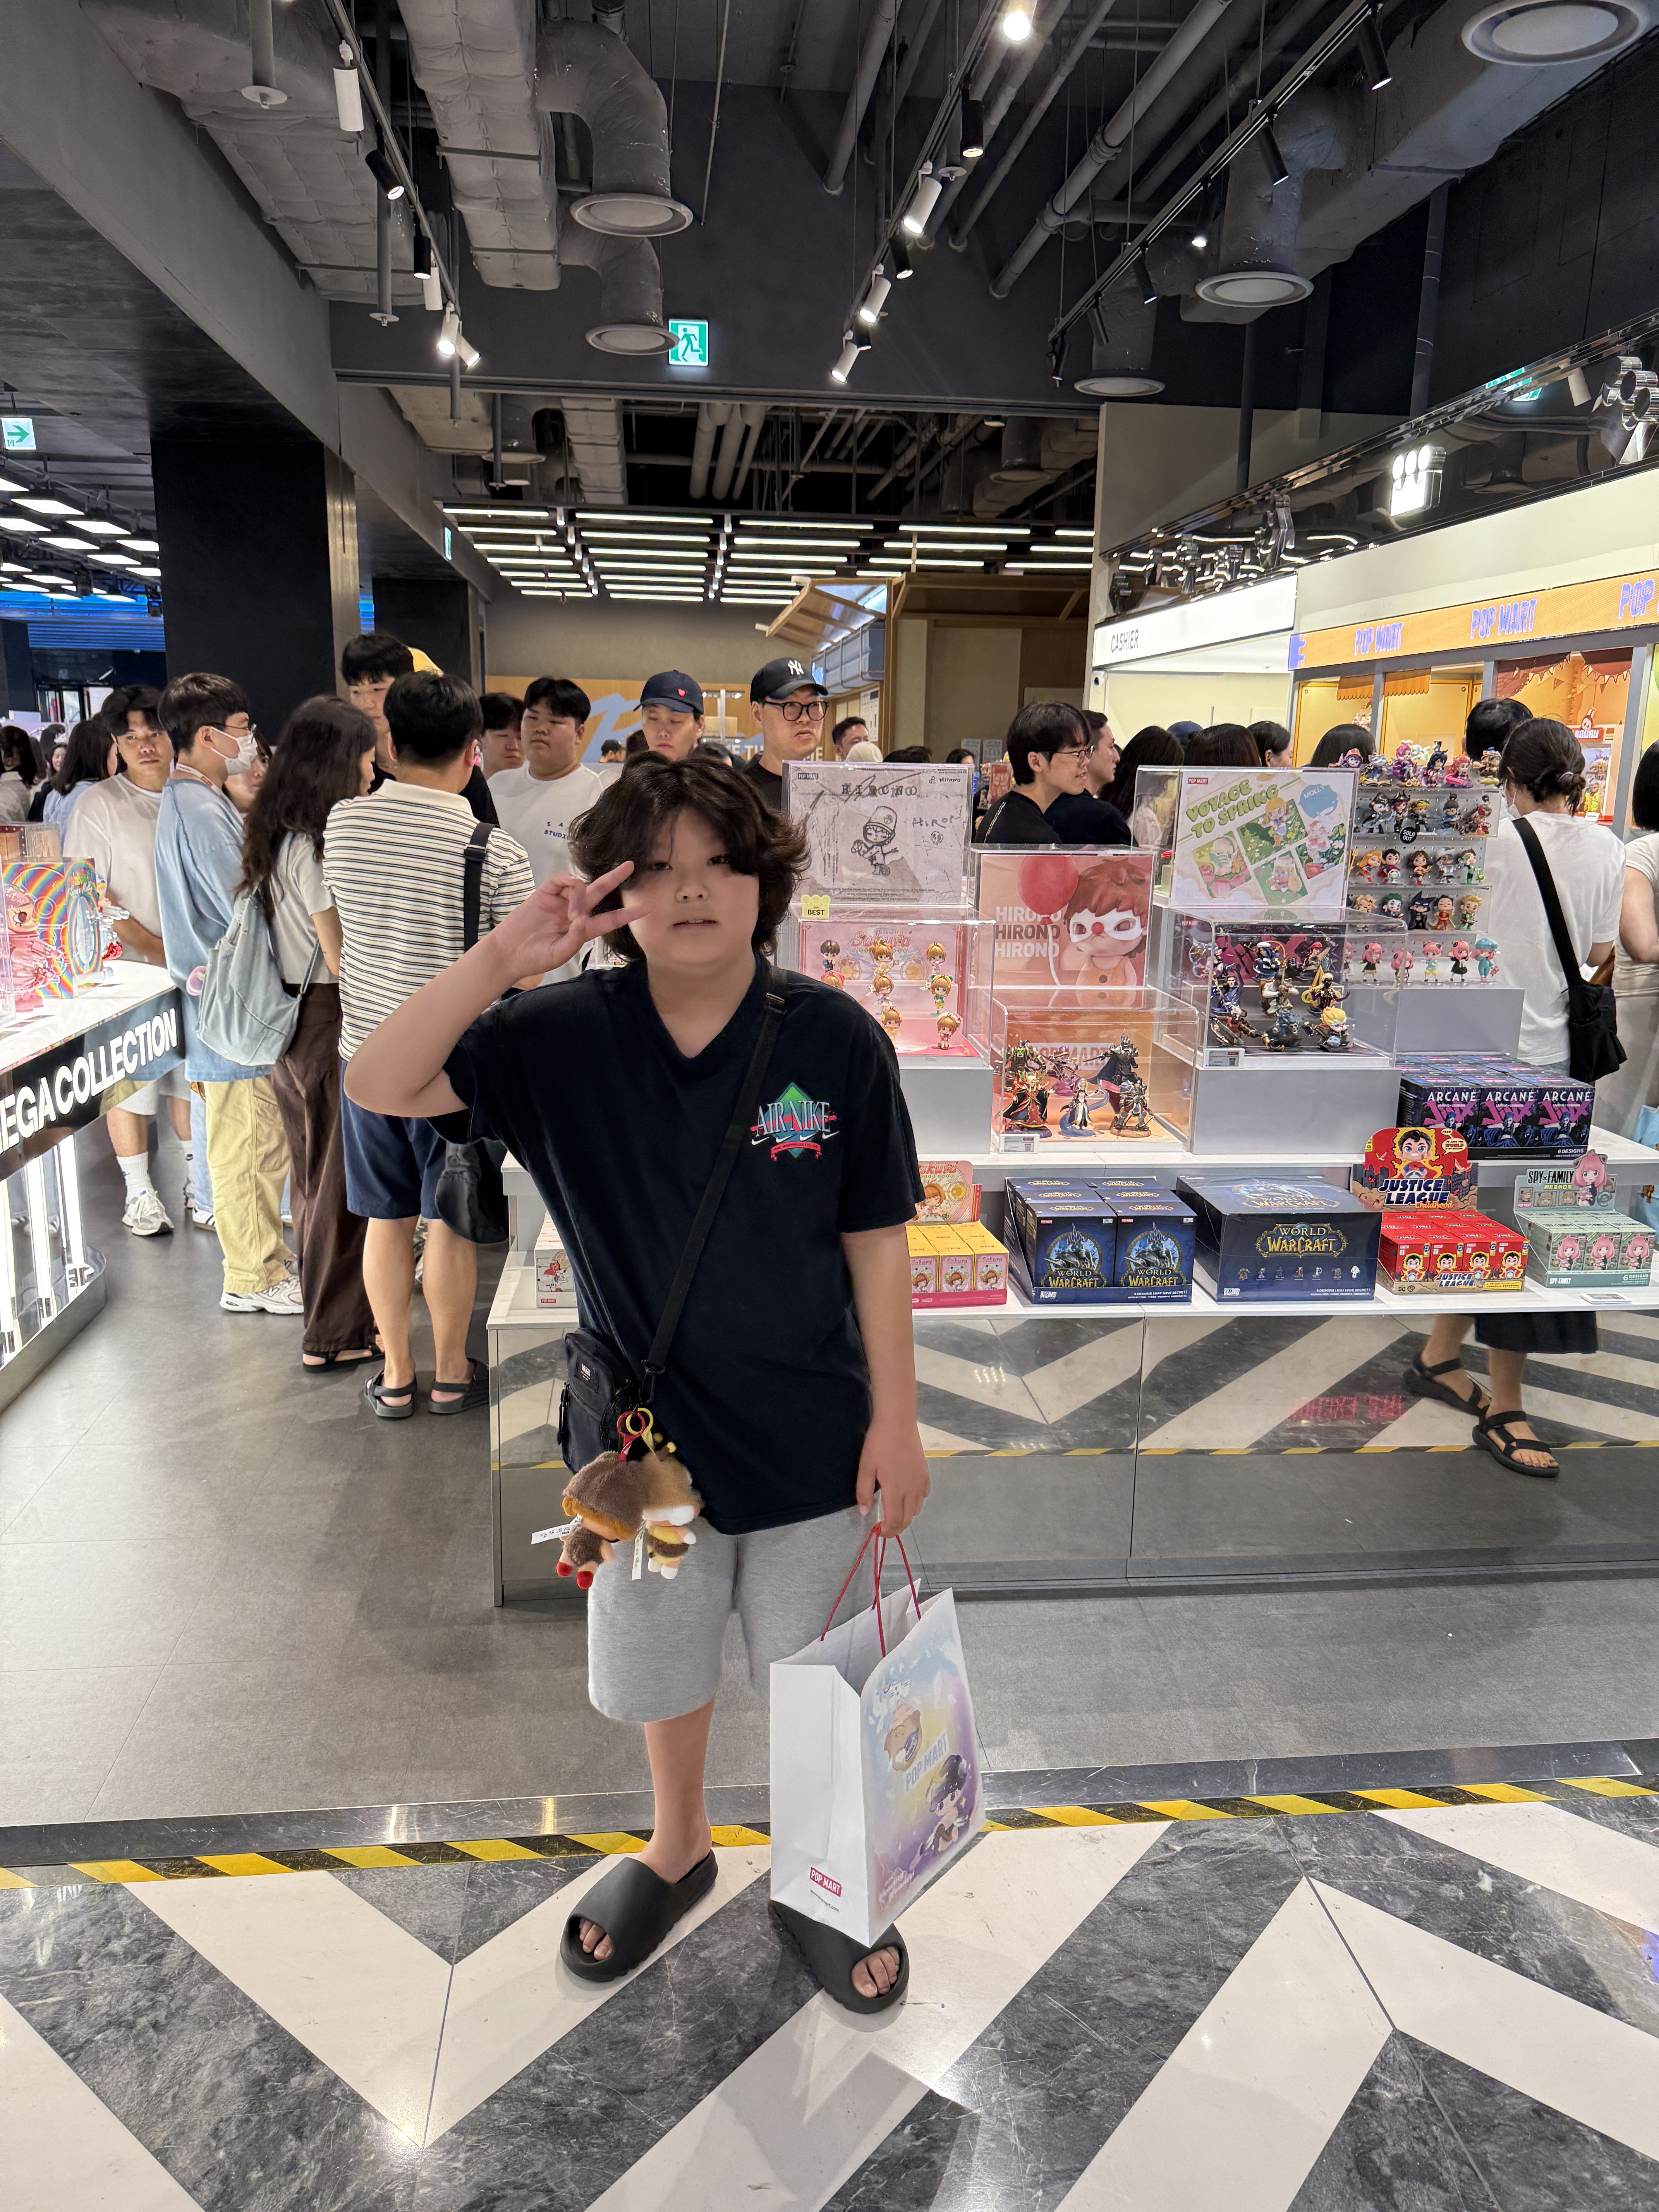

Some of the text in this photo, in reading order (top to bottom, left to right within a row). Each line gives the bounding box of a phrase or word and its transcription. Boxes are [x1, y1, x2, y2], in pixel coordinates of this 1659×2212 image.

[1618, 579, 1656, 619] POP
[1470, 599, 1538, 640] POP MART
[1111, 629, 1139, 654] CASHIER
[1354, 622, 1404, 656] POP MART
[1303, 785, 1325, 799] MOLLY
[1186, 779, 1252, 822] VOYAGE
[1191, 784, 1279, 838] TO SPRING
[995, 906, 1061, 922] HIROO
[995, 924, 1060, 940] HIRONO
[995, 942, 1060, 958] HIRONO
[0, 1008, 177, 1154] EGA COLLECTION
[1427, 1091, 1477, 1101] ARCANE
[1486, 1091, 1535, 1101] ARCANE
[1543, 1091, 1591, 1101] ARCANE
[756, 1101, 830, 1137] AIR NIKE
[919, 1161, 958, 1174] akura
[1378, 1179, 1444, 1192] JUSTICE
[1384, 1191, 1450, 1205] LEAGUE
[1415, 1200, 1454, 1209] Childhood
[1279, 1228, 1326, 1236] WORLD
[1436, 1273, 1473, 1281] JUSTICE
[1438, 1279, 1475, 1288] LEAGUE
[906, 1733, 947, 1792] POP MART
[811, 1869, 841, 1894] POP MART
